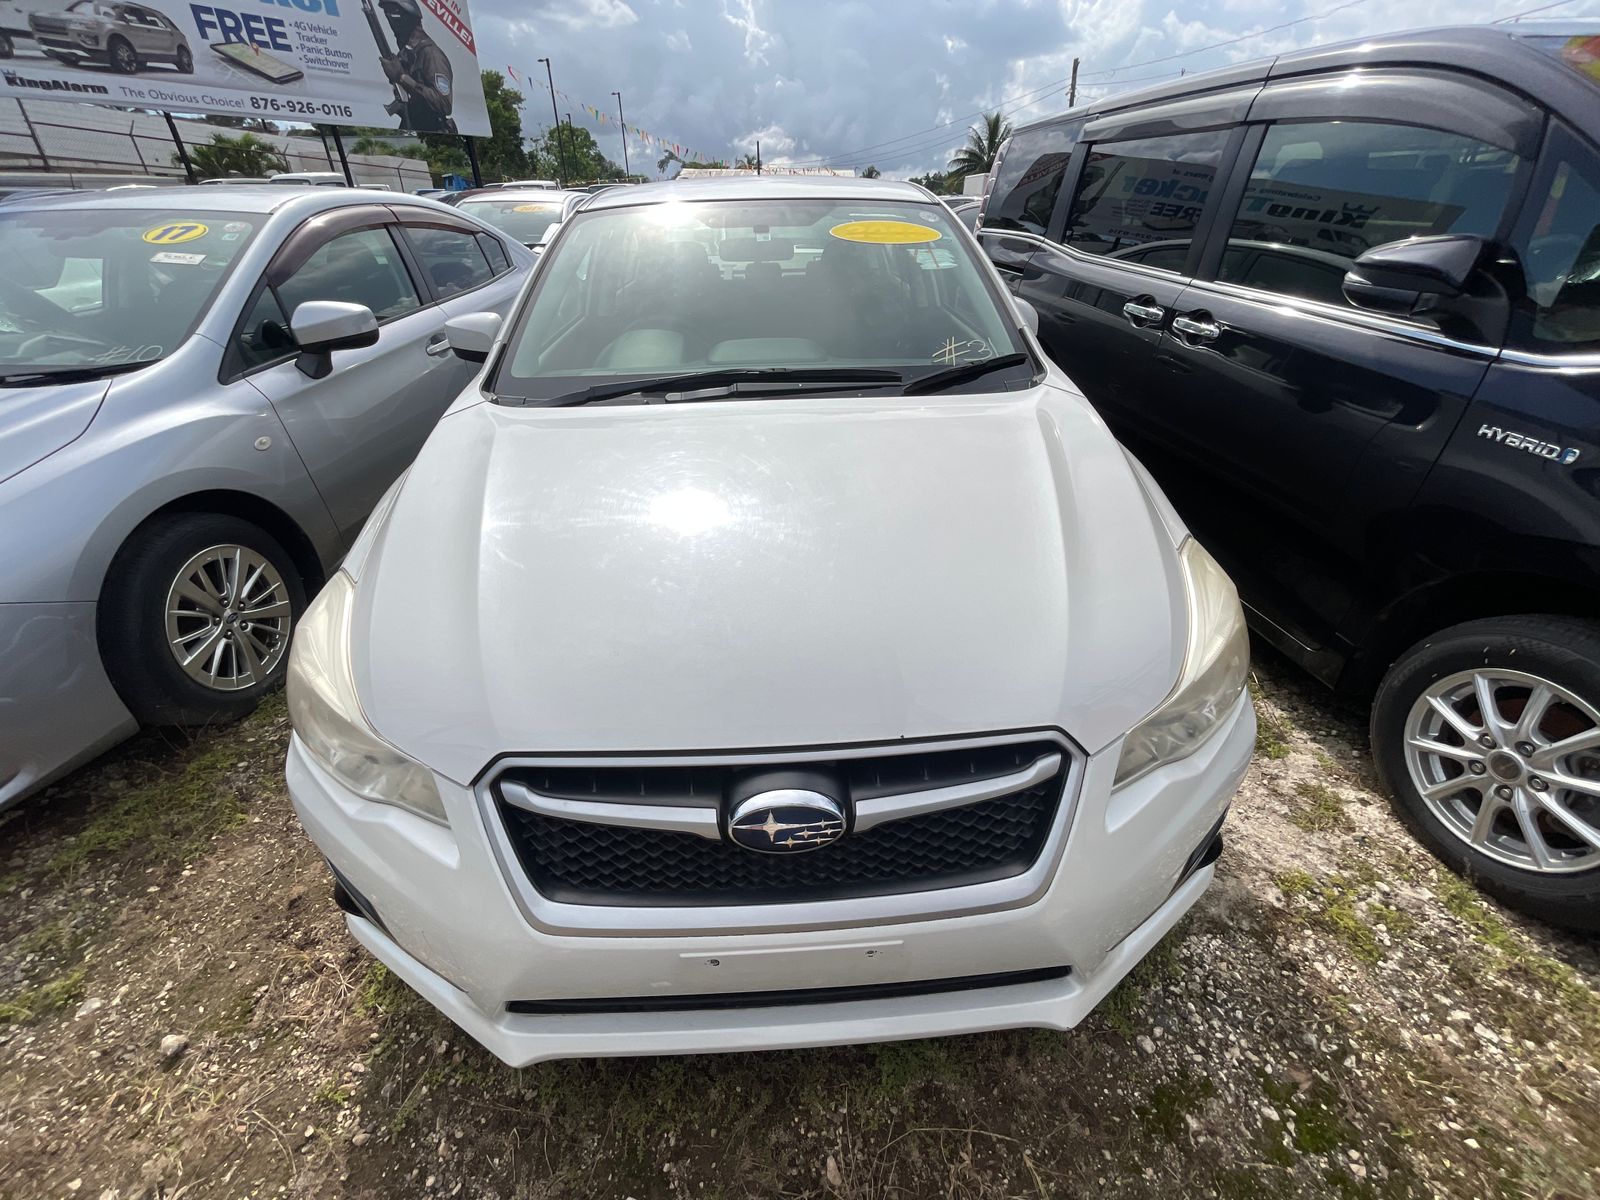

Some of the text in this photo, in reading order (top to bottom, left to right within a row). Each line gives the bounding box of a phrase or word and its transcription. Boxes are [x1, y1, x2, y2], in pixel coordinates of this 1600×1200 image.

[190, 3, 294, 52] FREE
[294, 21, 339, 37] 4G Vehicle
[296, 31, 328, 45] Tracker
[300, 43, 354, 60] Panic Button
[303, 54, 350, 70] Switchover
[5, 76, 109, 95] KingAlarm
[119, 86, 353, 118] The Obvious Choice! 876-926-0116
[150, 225, 200, 241] 17
[95, 344, 163, 364] #10
[1477, 424, 1561, 461] HYBRID
